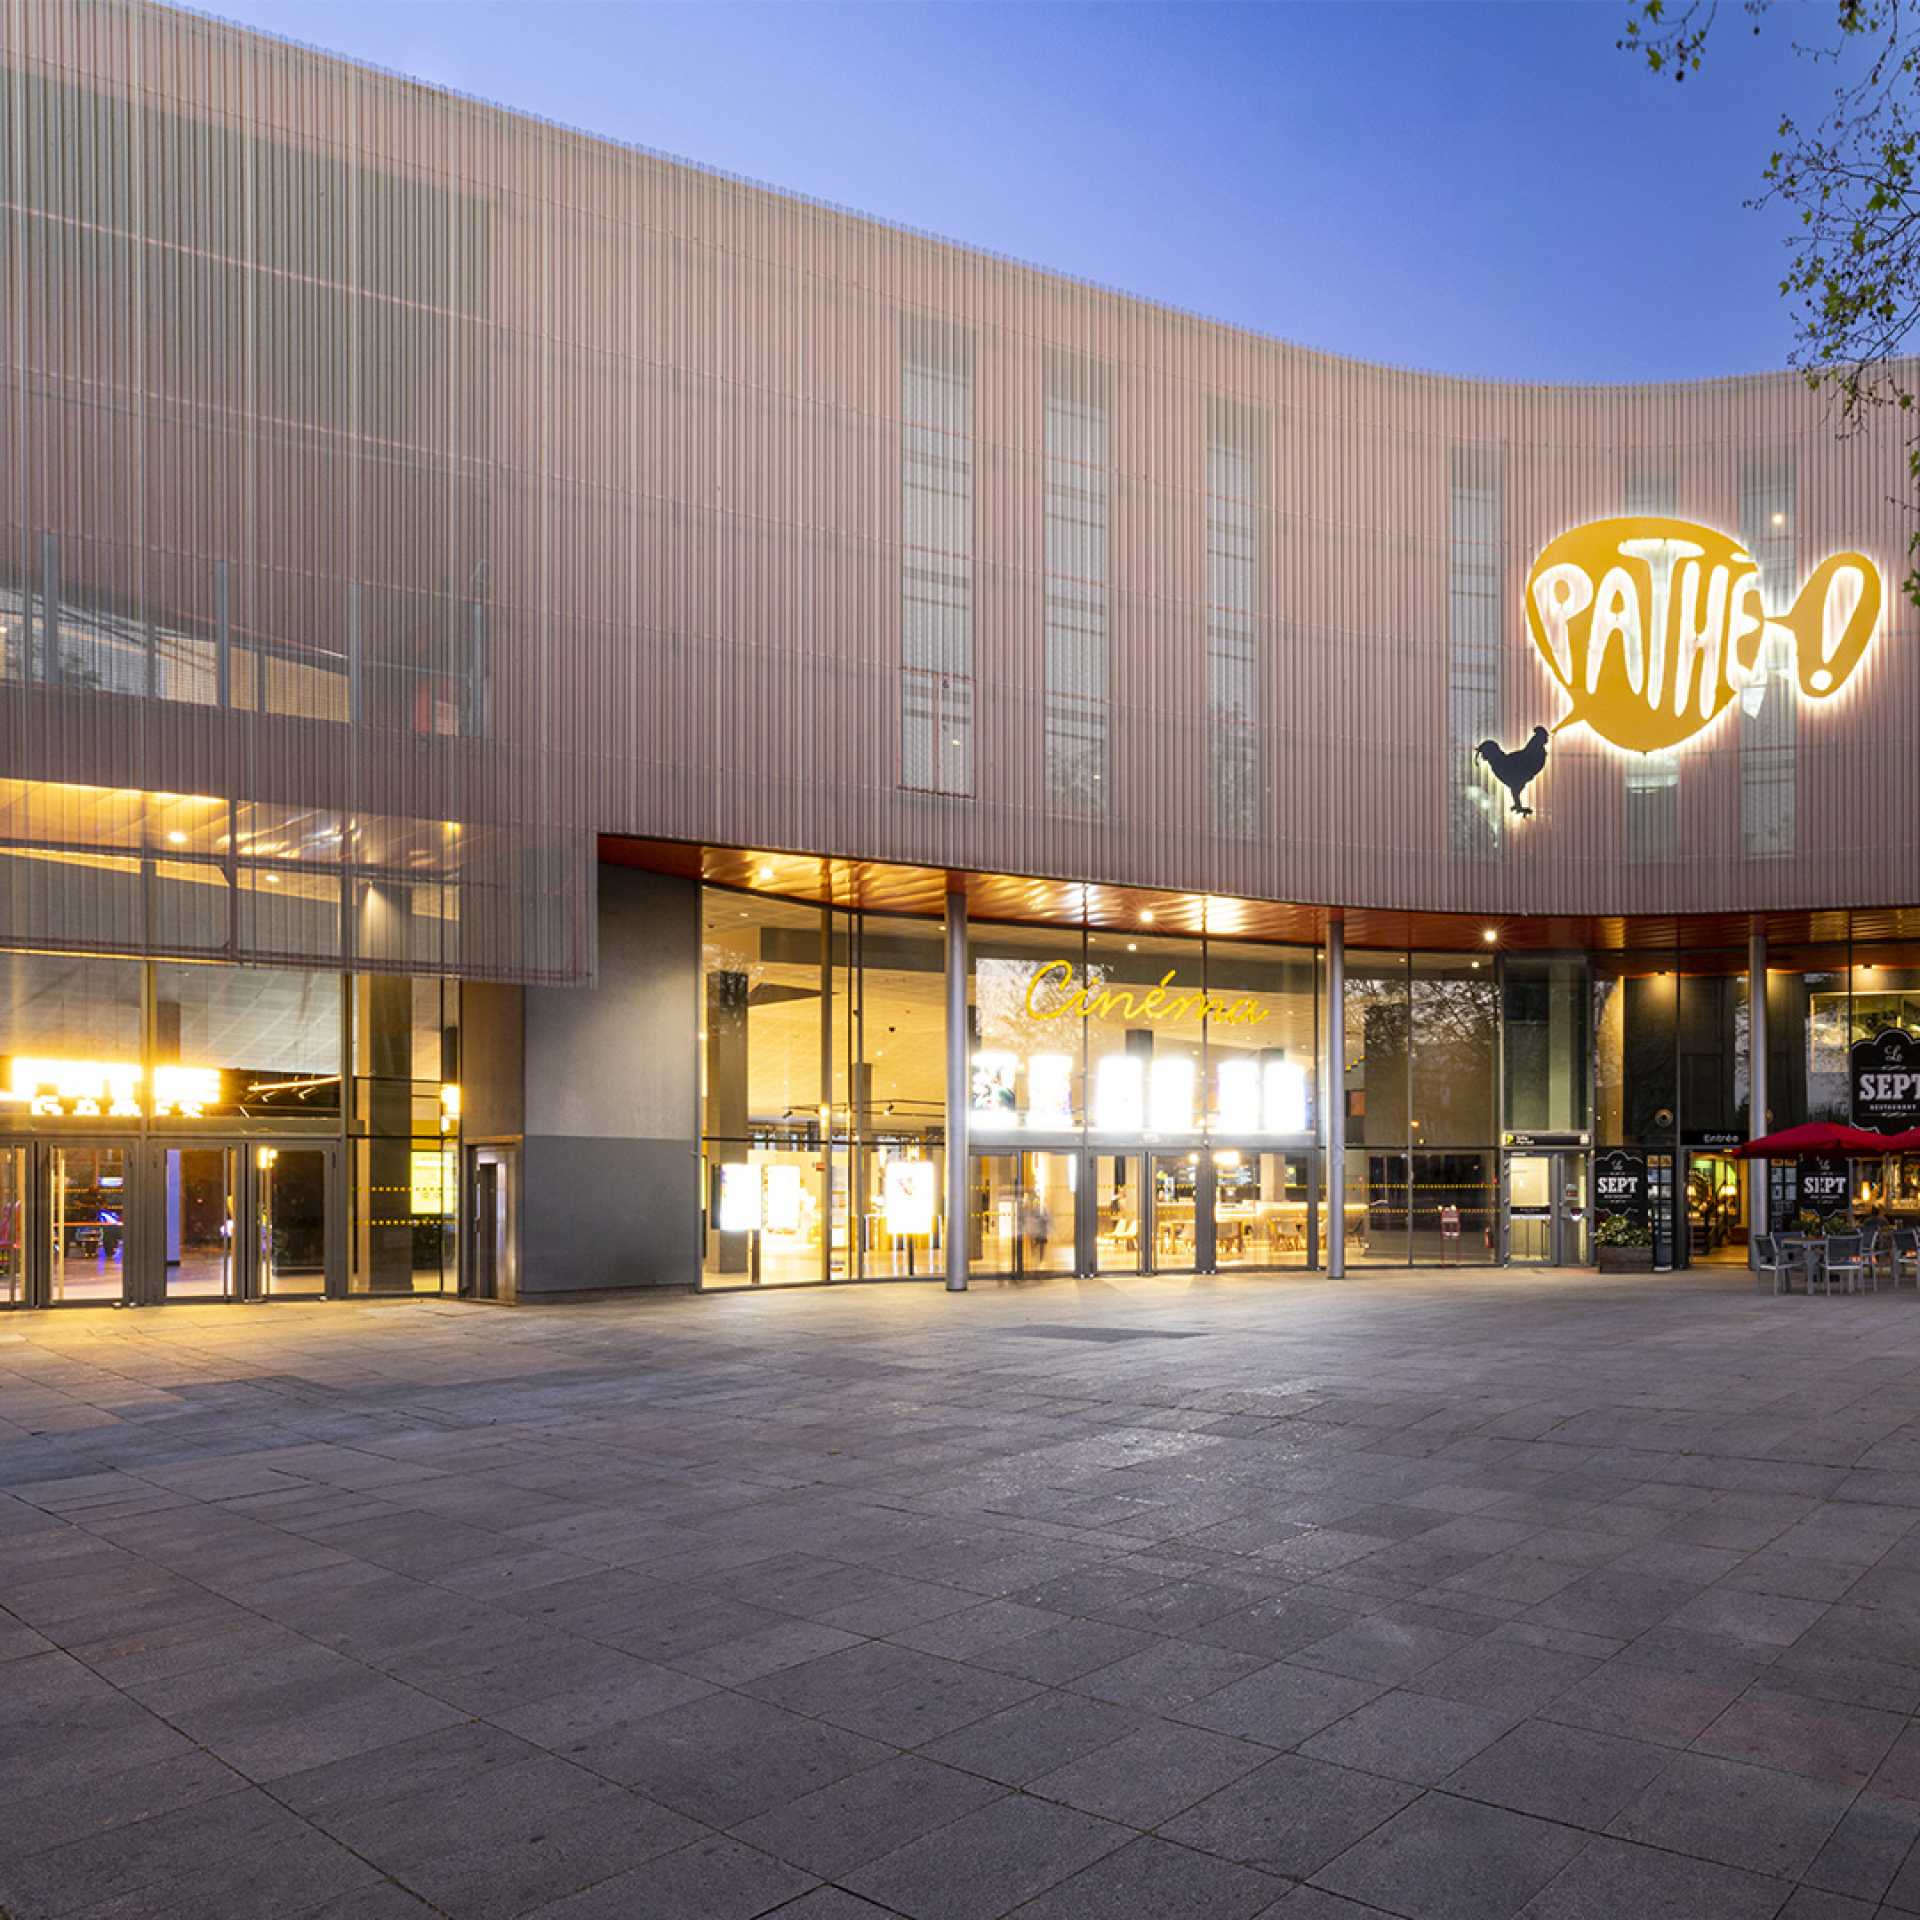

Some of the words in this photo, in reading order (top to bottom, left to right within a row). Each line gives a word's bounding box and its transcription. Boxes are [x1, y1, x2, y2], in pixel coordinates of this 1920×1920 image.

[1025, 960, 1272, 1025] Cinéma
[1859, 1072, 1920, 1101] SEPT
[1597, 1177, 1638, 1193] SEPT
[1803, 1176, 1846, 1193] SEPT
